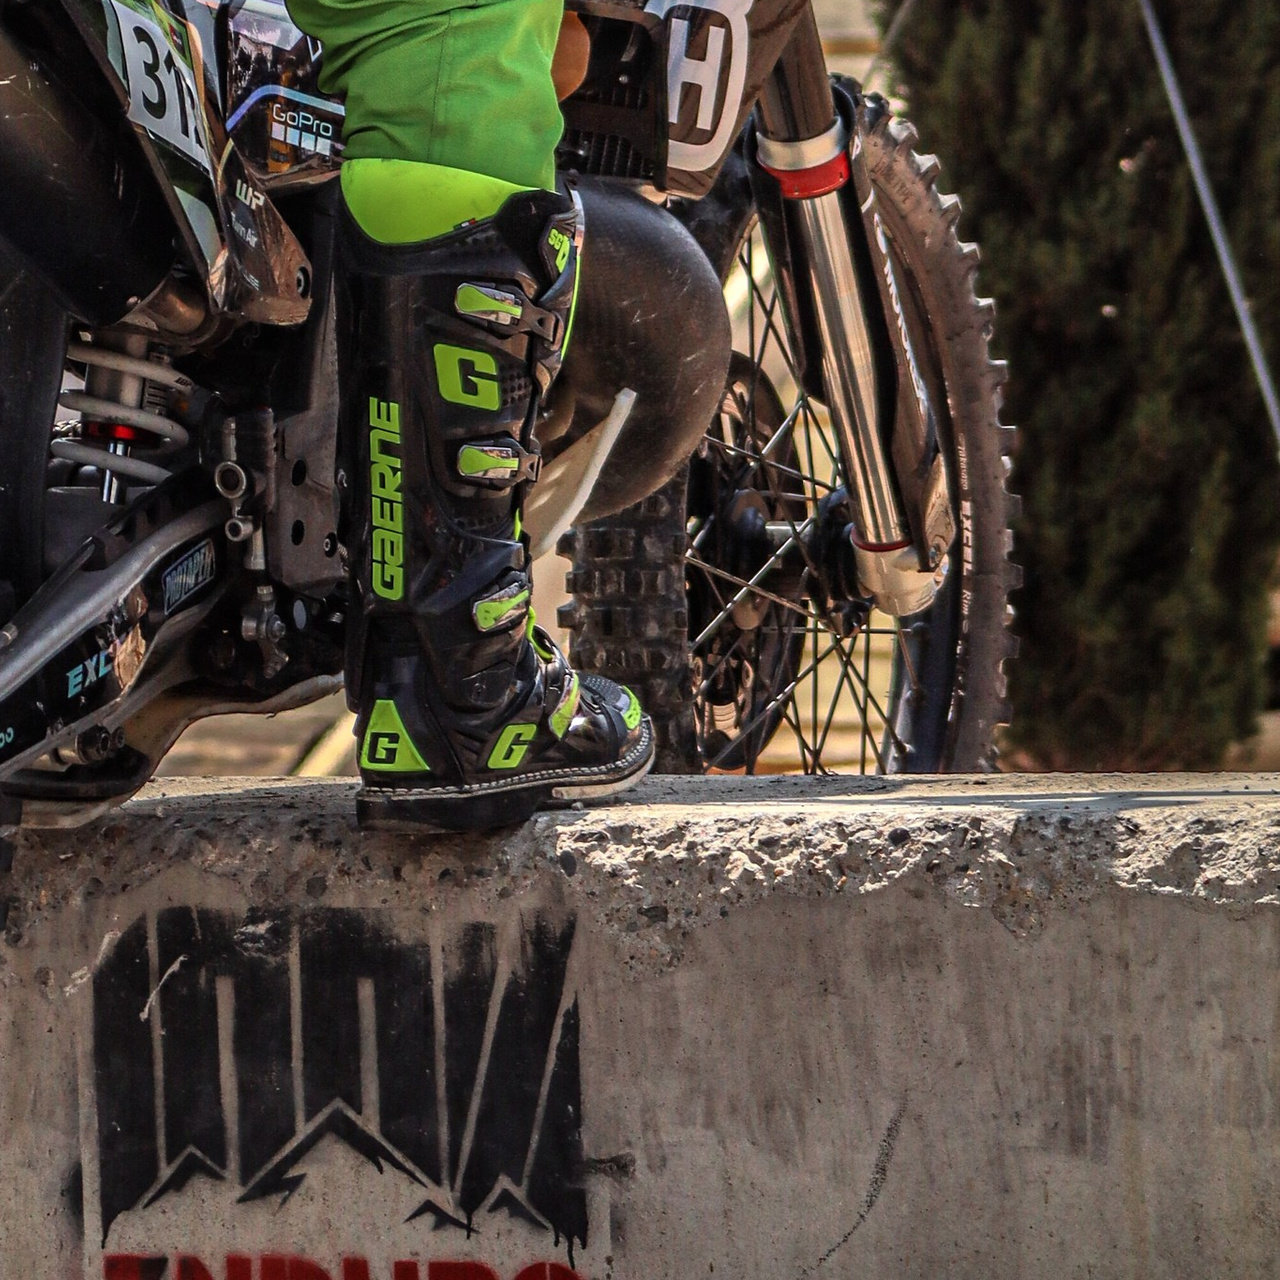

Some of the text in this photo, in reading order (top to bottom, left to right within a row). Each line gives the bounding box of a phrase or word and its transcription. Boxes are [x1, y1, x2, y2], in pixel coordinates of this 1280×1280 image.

[272, 103, 333, 137] GoPro
[433, 343, 501, 411] G
[367, 731, 401, 765] G
